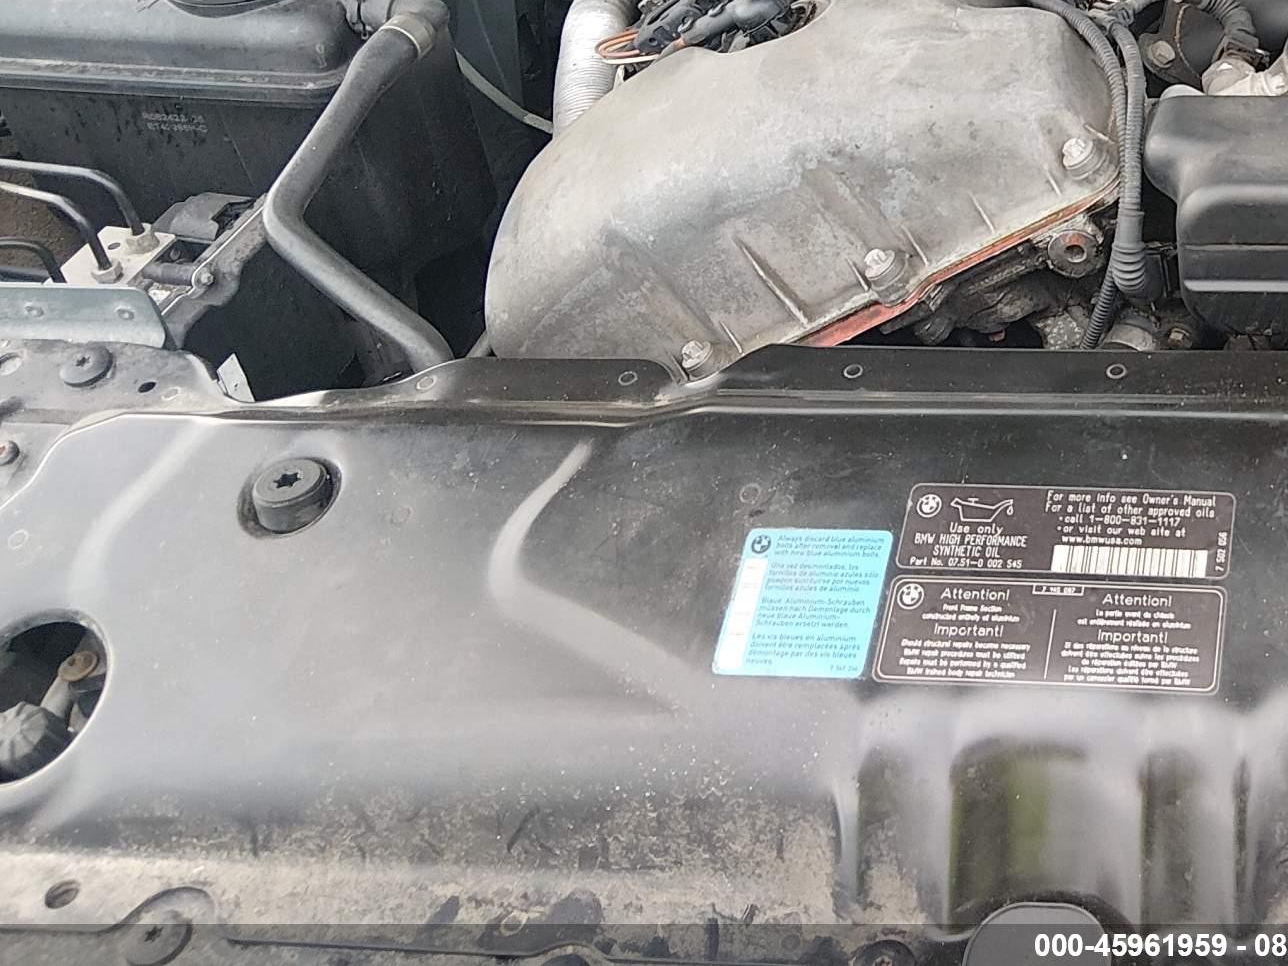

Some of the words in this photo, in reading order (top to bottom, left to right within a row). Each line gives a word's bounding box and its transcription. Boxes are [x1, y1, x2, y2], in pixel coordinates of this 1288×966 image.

[1047, 490, 1064, 502] For
[1068, 494, 1092, 503] more
[1120, 495, 1138, 504] see
[1142, 493, 1180, 506] Owner's
[1183, 495, 1216, 507] Manual
[1045, 501, 1062, 513] For
[1066, 504, 1074, 513] a
[1078, 502, 1096, 514] list
[1100, 503, 1113, 514] of
[1116, 504, 1144, 515] other
[1148, 507, 1191, 518] approved
[1195, 507, 1215, 518] oils
[950, 522, 970, 533] Use
[977, 523, 1004, 537] only
[1078, 524, 1103, 534] visit
[1106, 527, 1123, 535] our
[1128, 526, 1146, 536] web
[1150, 527, 1170, 537] site
[1174, 527, 1186, 538] at
[914, 532, 936, 545] BMW
[939, 533, 961, 545] HIGH
[964, 534, 1028, 548] PERFORMANCE
[1061, 534, 1143, 546] www.bmwusa.com
[932, 545, 982, 557] SYNTHETIC
[985, 546, 1000, 558] OIL
[910, 556, 928, 566] Part
[931, 557, 944, 566] No.
[987, 559, 1003, 568] 002
[940, 586, 1010, 601] Attention!
[1102, 594, 1172, 607] Attention!
[934, 622, 1004, 638] Important!
[1098, 628, 1168, 644] Important!
